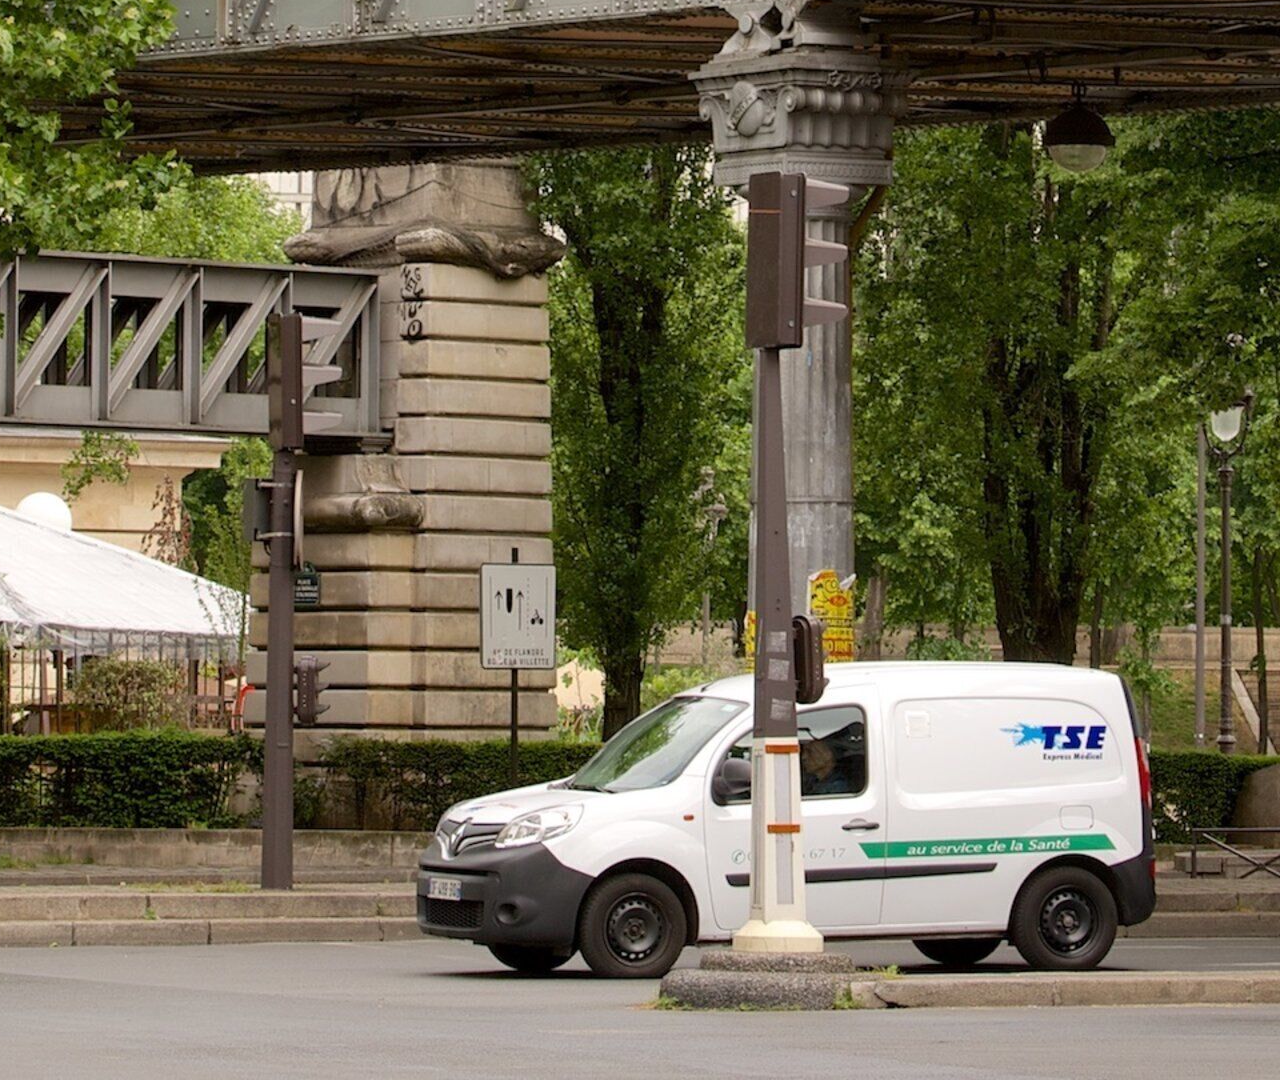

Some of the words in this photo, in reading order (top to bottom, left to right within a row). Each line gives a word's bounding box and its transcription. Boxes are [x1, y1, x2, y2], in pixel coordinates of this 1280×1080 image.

[1041, 726, 1107, 749] TSE
[1043, 753, 1072, 761] Express
[809, 849, 826, 859] 67
[832, 848, 846, 858] 17
[907, 846, 926, 855] au
[930, 842, 983, 854] service
[987, 840, 1006, 852] de
[1009, 840, 1023, 851] la
[1029, 838, 1070, 851] Santé
